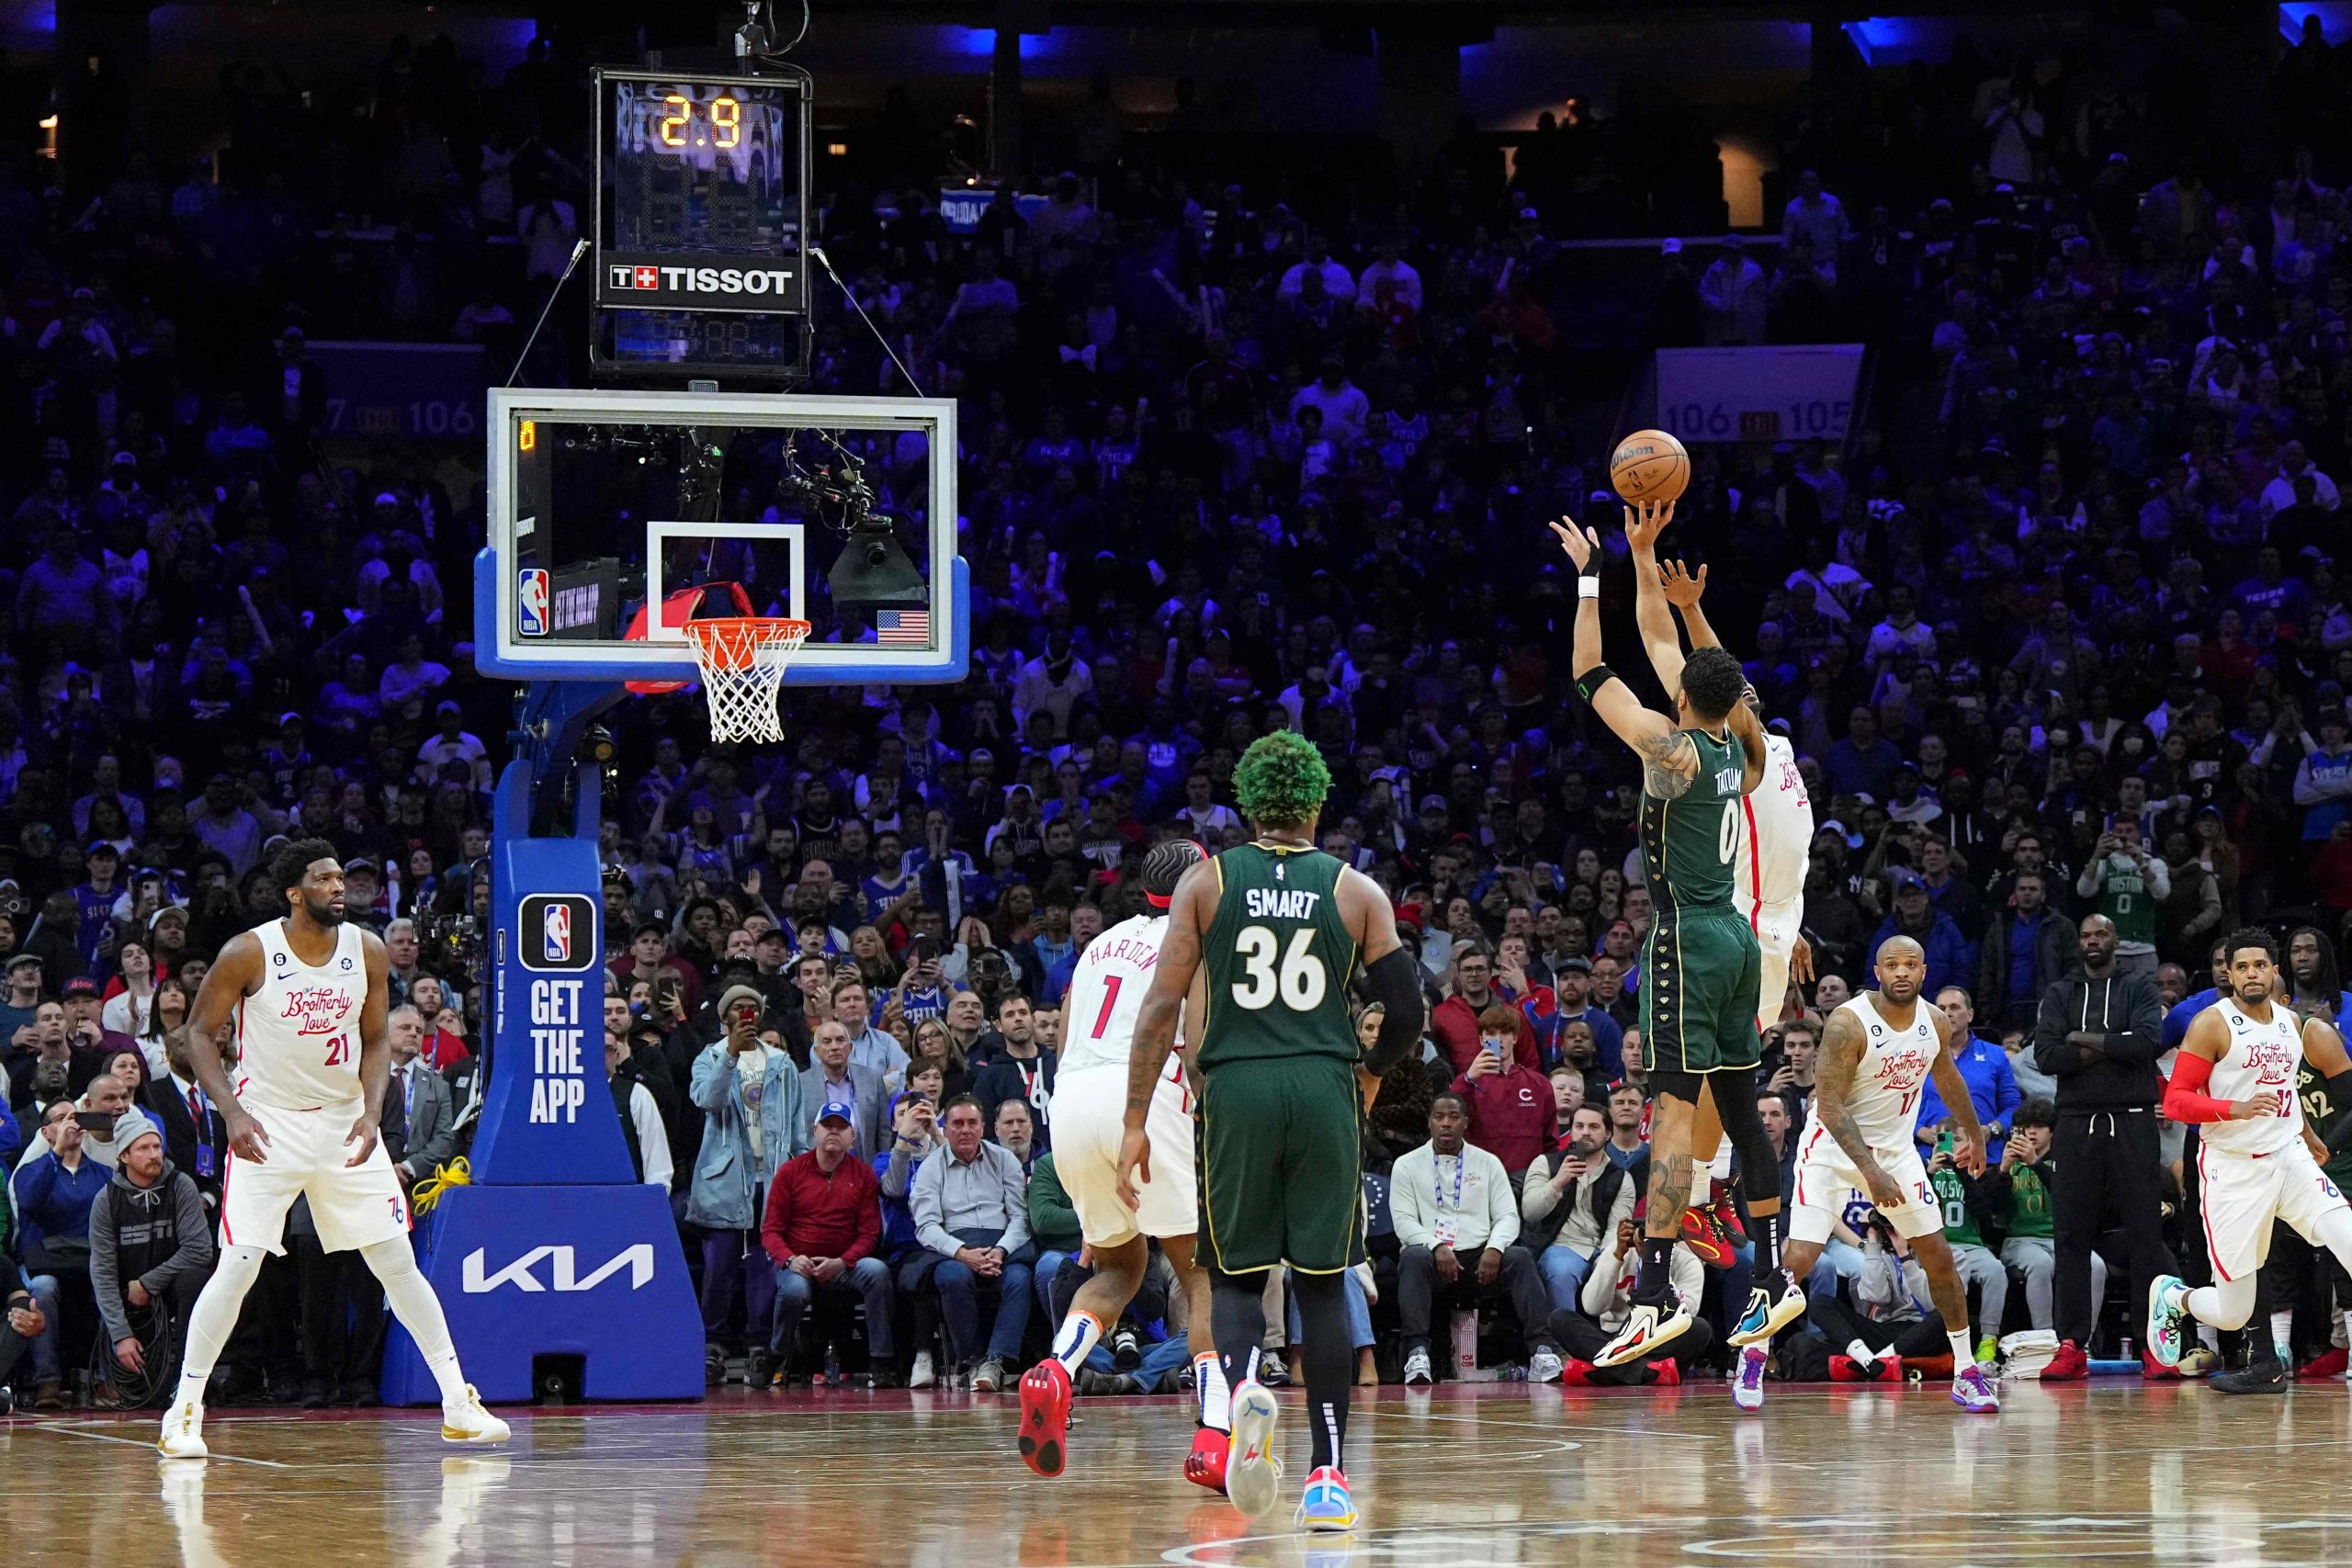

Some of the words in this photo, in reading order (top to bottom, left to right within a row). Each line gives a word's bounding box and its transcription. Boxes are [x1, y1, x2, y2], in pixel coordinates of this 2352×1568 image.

[662, 96, 740, 148] 2.9
[661, 267, 793, 295] TISSOT
[409, 400, 475, 434] 106
[1668, 402, 1730, 434] 106
[1792, 400, 1851, 434] 105
[523, 619, 537, 631] NBA
[1715, 768, 1742, 795] TATUM
[1719, 797, 1739, 865] 0
[1246, 888, 1320, 920] SMART
[2117, 894, 2132, 915] 0
[276, 953, 284, 964] 6
[548, 947, 560, 958] NBA
[1090, 939, 1159, 972] HARDEN
[1231, 925, 1327, 1012] 36
[281, 988, 353, 1020] Brotherly
[530, 979, 583, 1025] GET
[903, 1007, 944, 1025] PHIL
[1091, 975, 1124, 1040] 1
[298, 1011, 339, 1036] Love
[324, 1032, 349, 1066] 21
[529, 1029, 584, 1075] THE
[1874, 1049, 1929, 1078] Brotherly
[2243, 1043, 2295, 1073] Brotherly
[1883, 1073, 1916, 1090] Love
[2256, 1064, 2287, 1086] Love
[529, 1078, 585, 1123] APP
[1519, 1088, 1532, 1101] C
[2277, 1089, 2293, 1118] 12
[2301, 1090, 2335, 1120] 42
[1914, 1180, 1934, 1205] 76
[2316, 1177, 2338, 1198] 76
[388, 1196, 404, 1224] 76
[1945, 1201, 1965, 1228] 0
